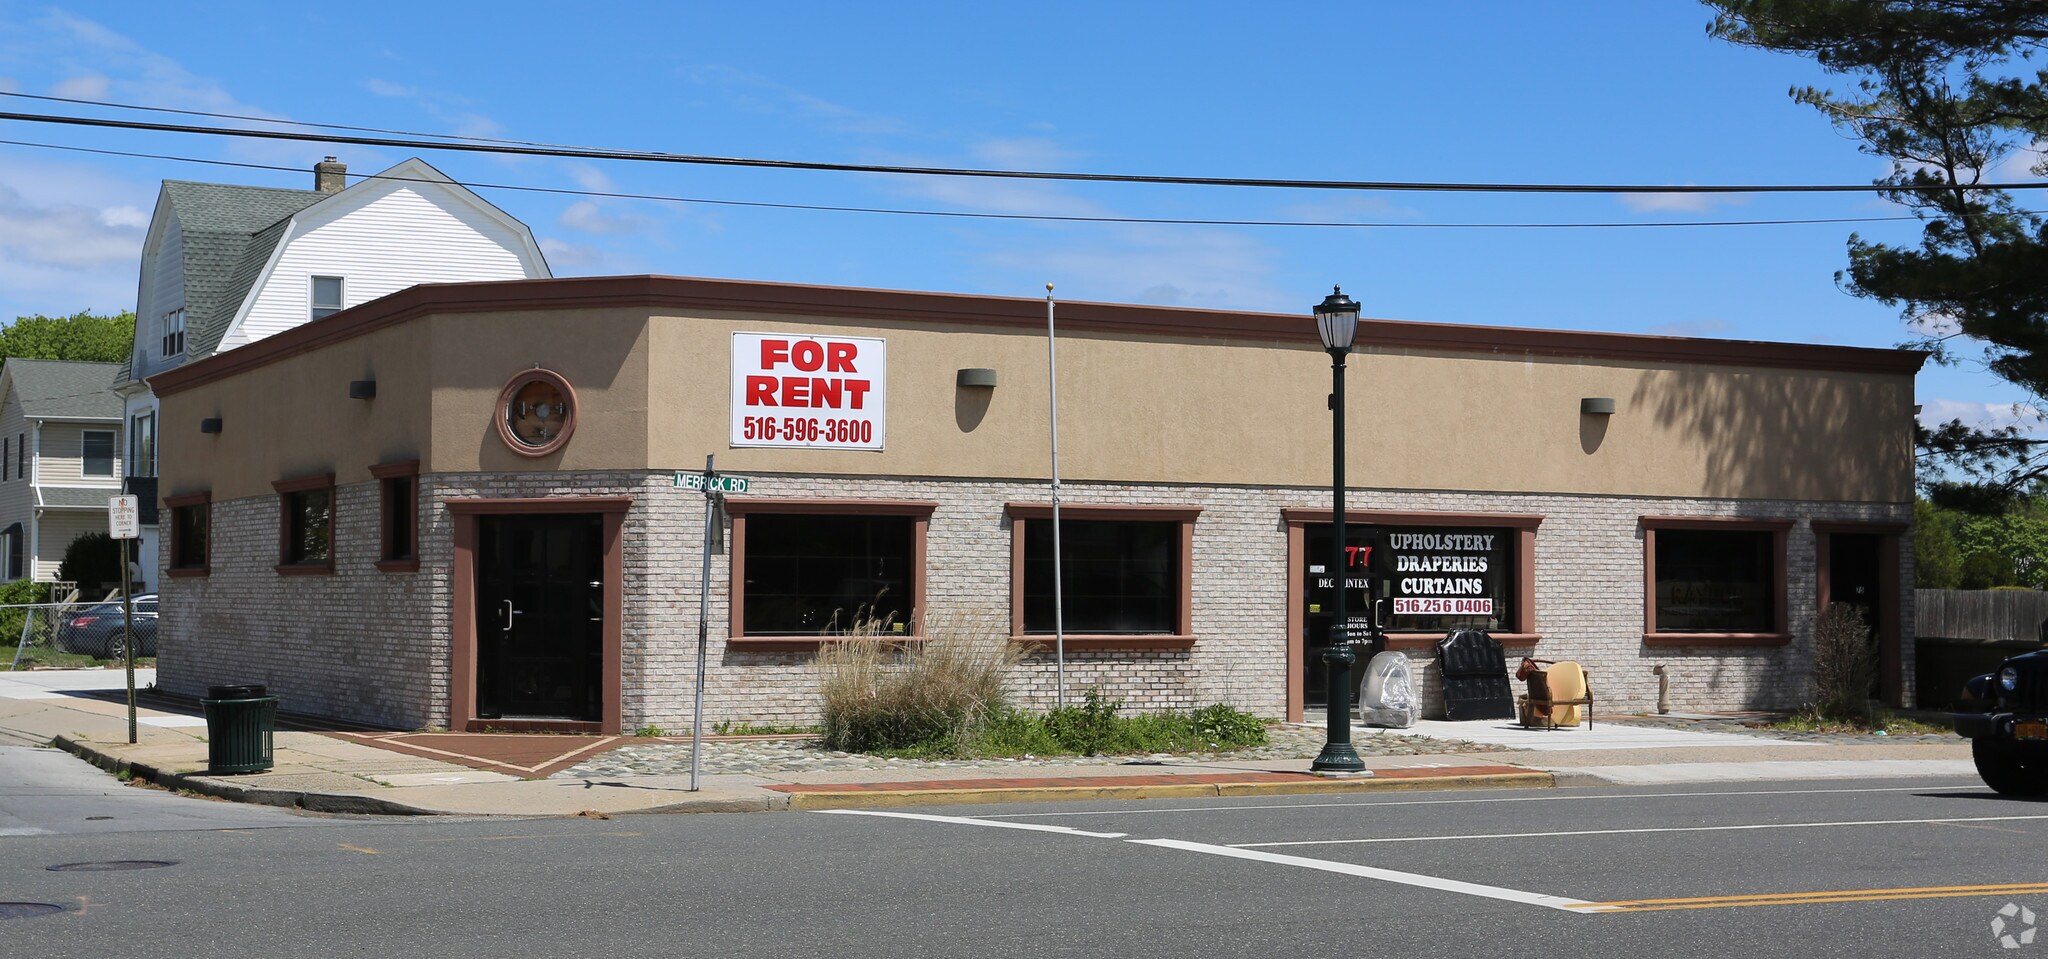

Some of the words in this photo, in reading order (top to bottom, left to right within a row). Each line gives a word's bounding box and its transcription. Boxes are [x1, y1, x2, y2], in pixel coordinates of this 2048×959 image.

[760, 339, 858, 373] FOR
[745, 375, 870, 409] RENT
[743, 416, 872, 443] 516-596-3600
[676, 473, 726, 491] MERRICK
[730, 478, 746, 492] RD
[1390, 533, 1495, 551] UPHOLSTERY
[1344, 546, 1373, 567] 77
[1396, 555, 1488, 573] DRAPERIES
[1401, 577, 1483, 595] CURTAINS
[1455, 599, 1491, 613] 0406
